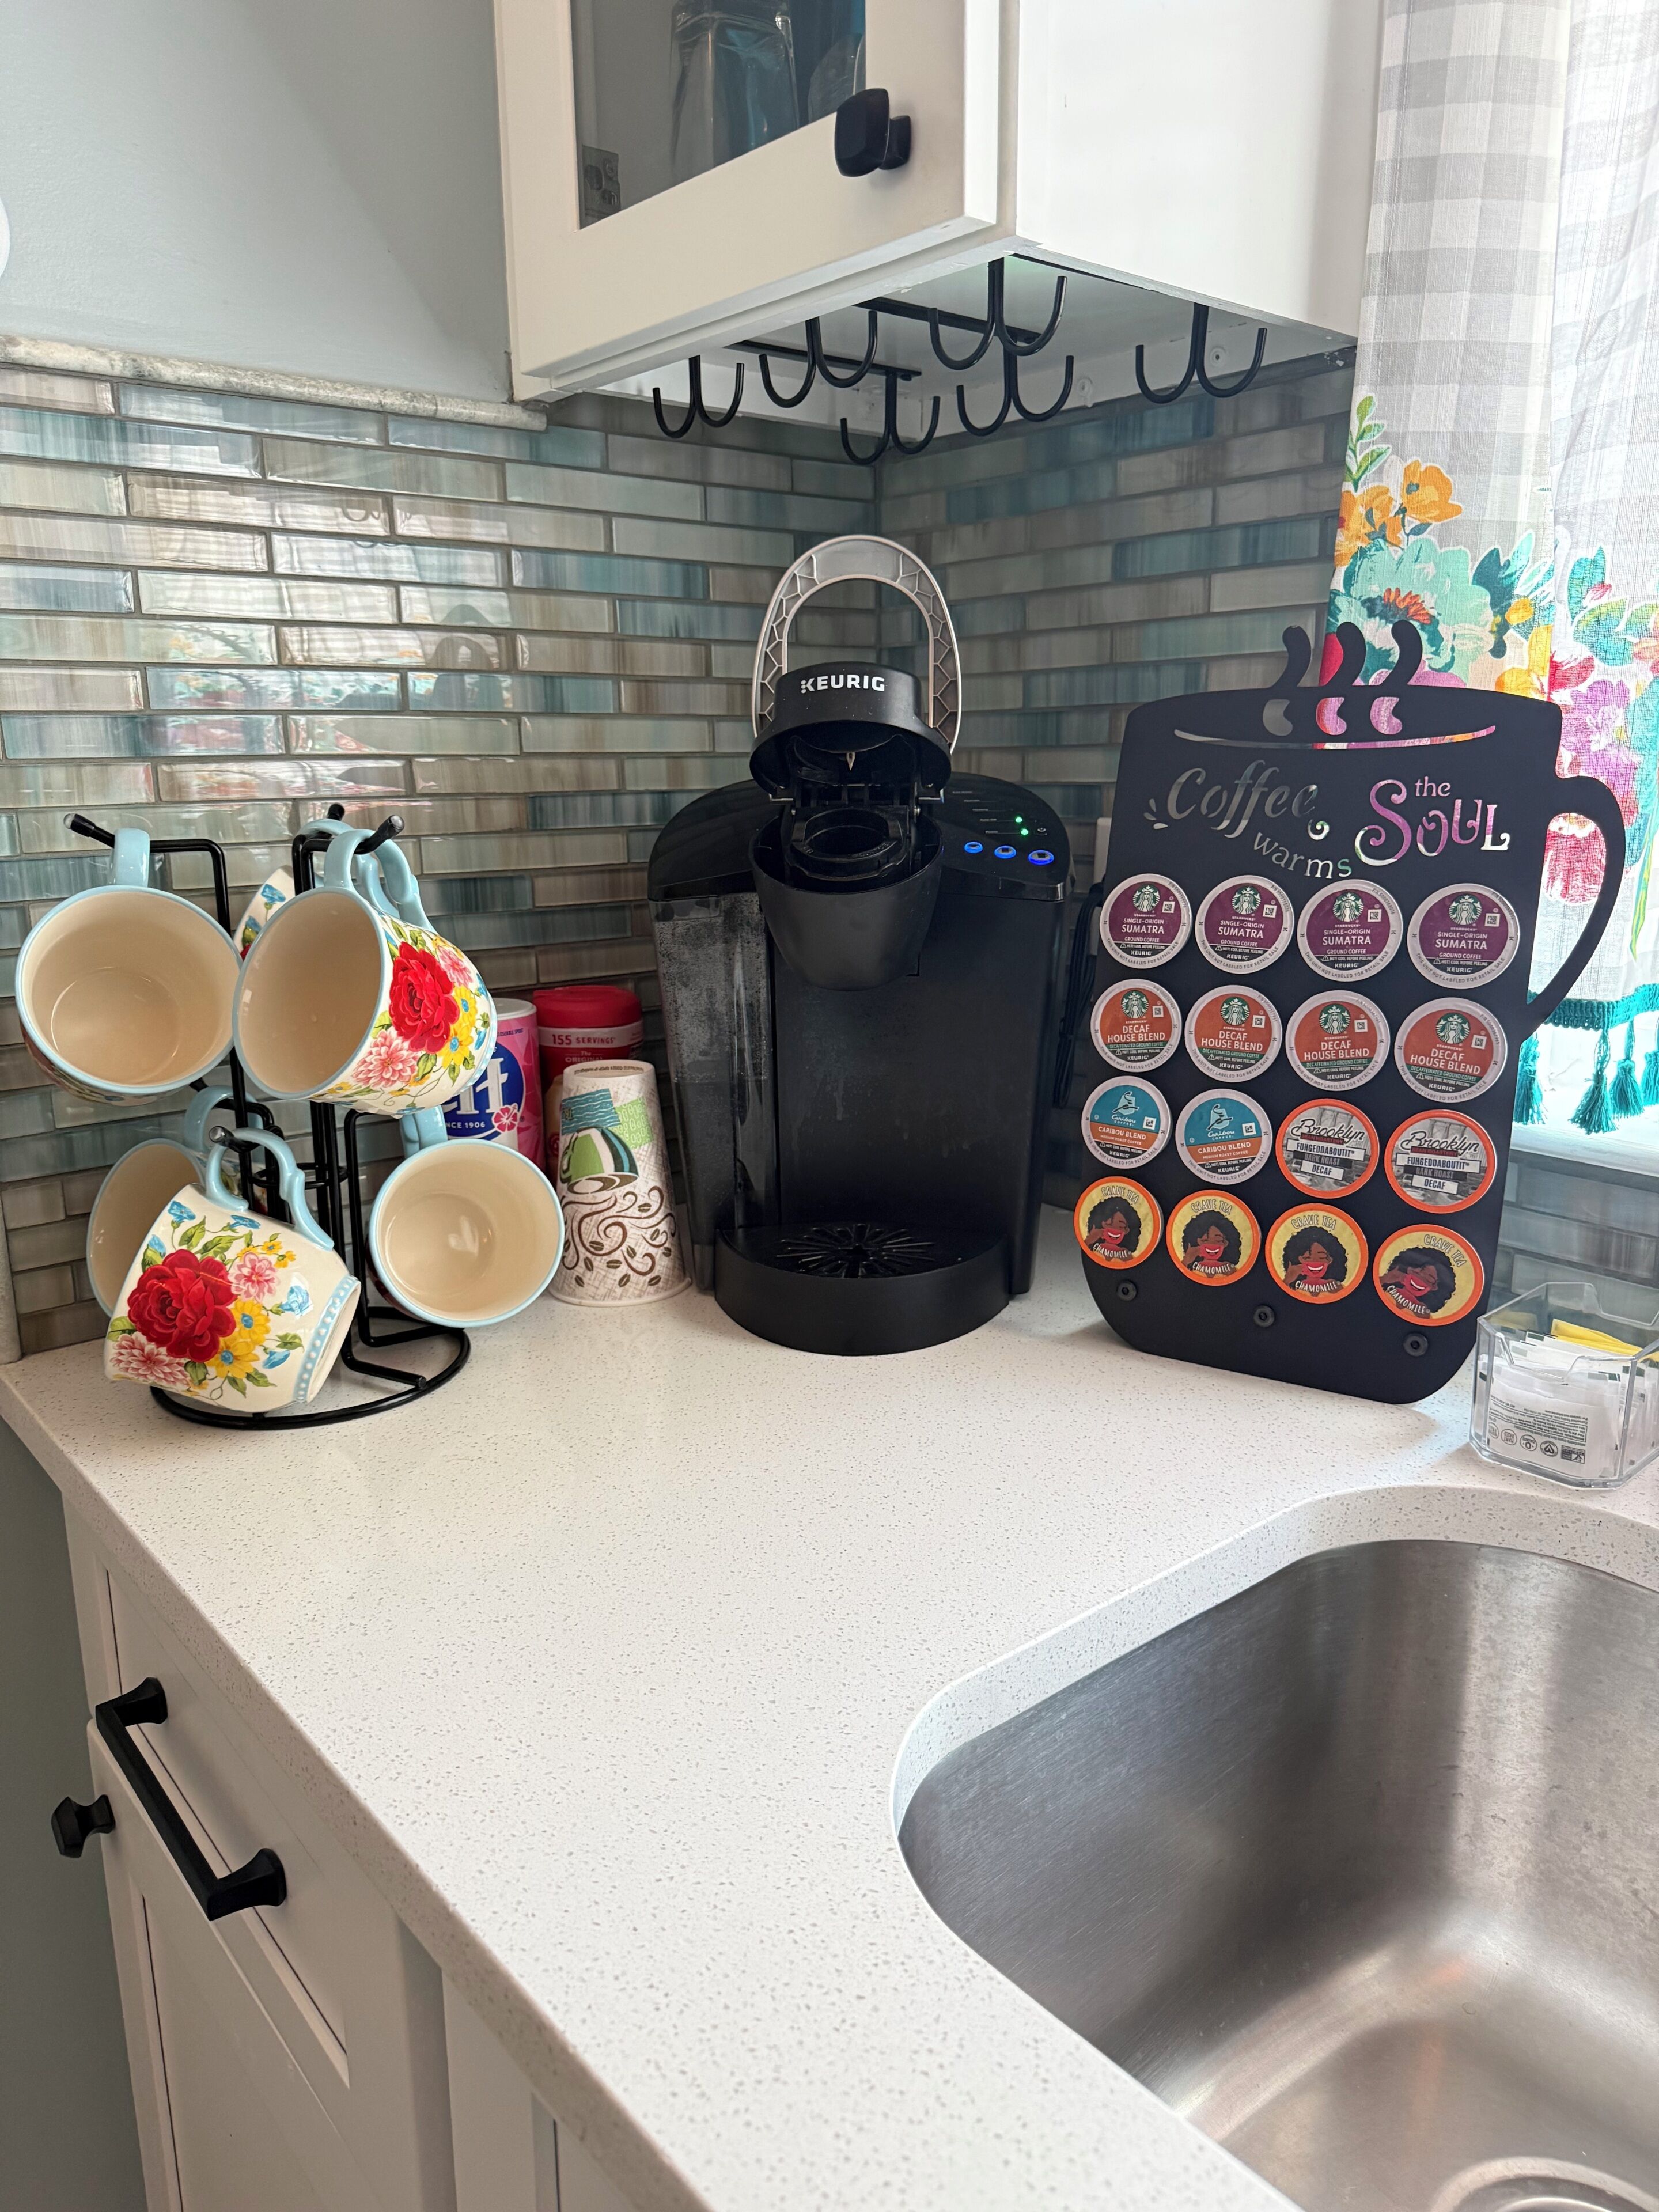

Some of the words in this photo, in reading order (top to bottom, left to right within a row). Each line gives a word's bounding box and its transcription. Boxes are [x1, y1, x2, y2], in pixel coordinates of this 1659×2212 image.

[801, 674, 885, 694] KEURIG
[1415, 775, 1451, 797] the
[1167, 760, 1328, 839] Coffee
[1252, 831, 1353, 879] warms
[1122, 925, 1164, 934] SUMATRA
[1220, 920, 1264, 929] SINGLE-ORIGIN
[1218, 927, 1263, 938] SUMATRA
[1323, 936, 1371, 945] SUMATRA
[1435, 939, 1487, 950] SUMATRA
[1122, 1024, 1150, 1033] DECAF
[552, 1034, 572, 1046] 155
[576, 1036, 614, 1044] SERVINGS
[1107, 1034, 1136, 1043] HOUSE
[1138, 1032, 1165, 1041] BLEND
[1219, 1031, 1248, 1041] DECAF
[1201, 1037, 1232, 1049] HOUSE
[1234, 1041, 1263, 1051] BLEND
[1321, 1040, 1352, 1050] DECAF
[1304, 1050, 1336, 1060] HOUSE
[1339, 1048, 1369, 1058] BLEND
[1431, 1048, 1465, 1062] DECAF
[1410, 1054, 1446, 1069] HOUSE
[1447, 1061, 1480, 1074] BLEND
[1411, 1066, 1443, 1076] DECAFFEINATED
[1429, 1083, 1453, 1092] KEURIG
[464, 1120, 486, 1128] 1906
[1111, 1113, 1136, 1124] Caribou
[1098, 1126, 1124, 1136] CARIBOU
[1125, 1132, 1146, 1141] BLEND
[1291, 1118, 1365, 1144] Brooklyn
[1198, 1145, 1226, 1154] CARIBOU
[1228, 1142, 1251, 1150] BLEND
[1296, 1142, 1350, 1157] FUHGEDDABOUTIT
[1400, 1131, 1479, 1156] Brooklyn
[1304, 1153, 1320, 1162] DARK
[1320, 1156, 1339, 1165] ROAST
[1407, 1156, 1466, 1170] FUHGEDDABOUTIT
[1312, 1165, 1332, 1176] DECAF
[1416, 1166, 1433, 1176] DARK
[1433, 1169, 1454, 1179] ROAST
[1423, 1178, 1446, 1190] DECAF
[1101, 1185, 1125, 1198] CRAVE
[1126, 1189, 1139, 1205] TEA
[1190, 1199, 1217, 1213] CRAVE
[1219, 1200, 1233, 1215] TEA
[1291, 1214, 1319, 1229] CRAVE
[1321, 1215, 1337, 1230] TEA
[1093, 1243, 1127, 1259] CHAMOMILE
[1423, 1234, 1454, 1254] CRAVE
[1451, 1249, 1467, 1268] TEA
[1192, 1261, 1230, 1274] CHAMOMILE
[1295, 1280, 1337, 1293] CHAMOMILE
[1387, 1285, 1425, 1314] CHAMOMILE
